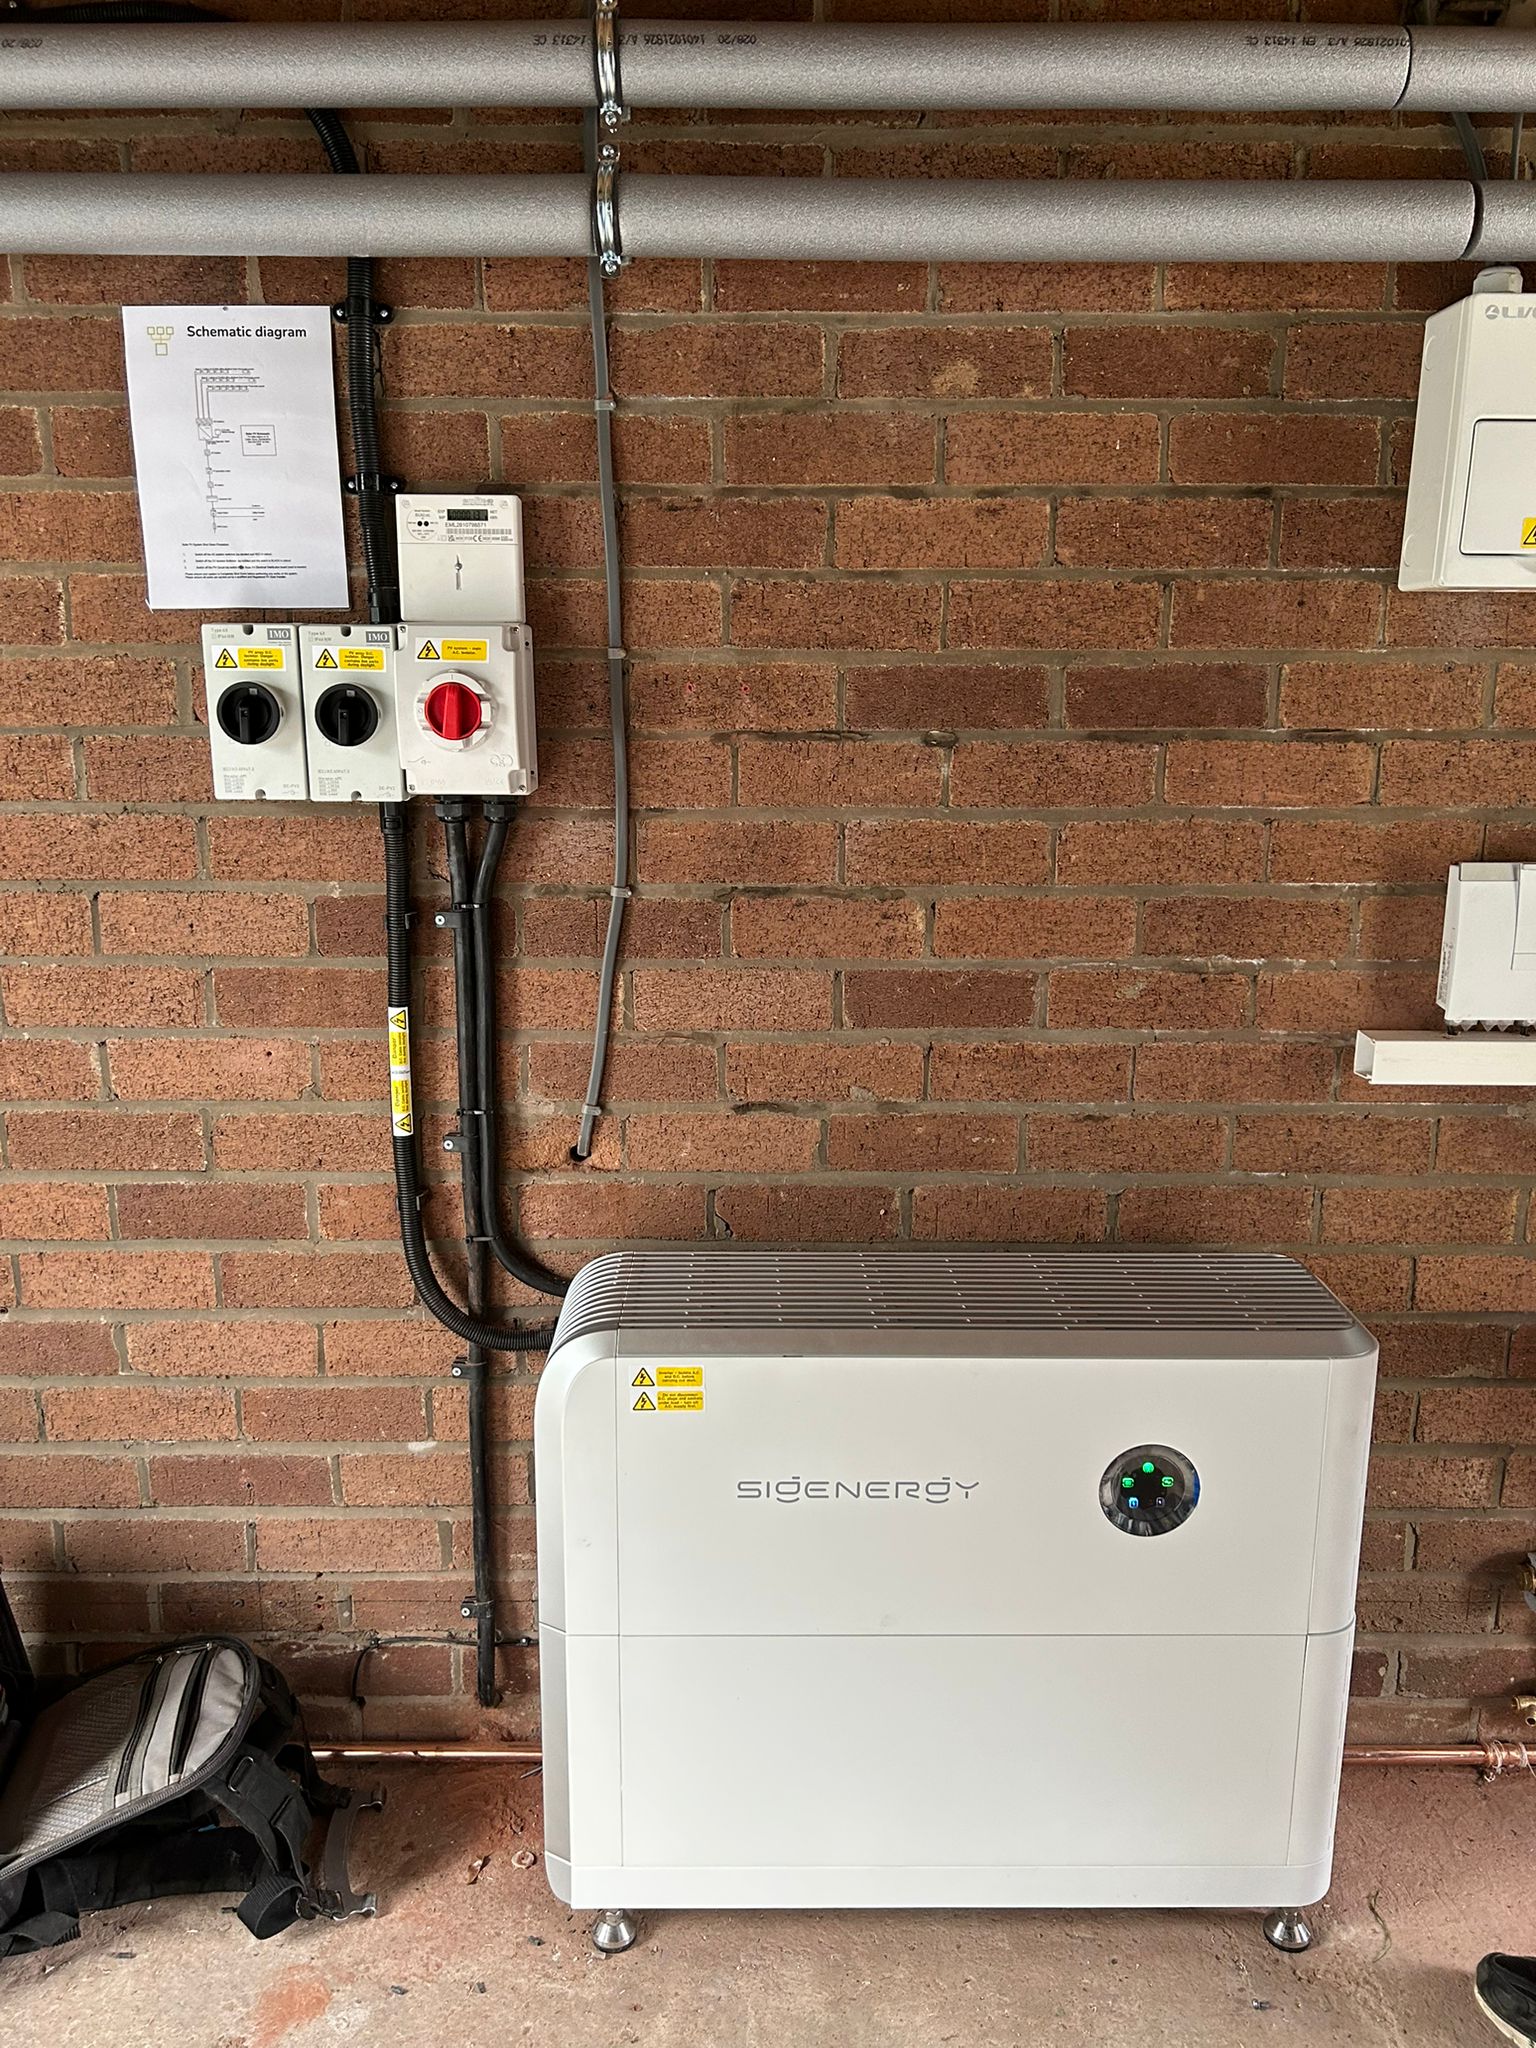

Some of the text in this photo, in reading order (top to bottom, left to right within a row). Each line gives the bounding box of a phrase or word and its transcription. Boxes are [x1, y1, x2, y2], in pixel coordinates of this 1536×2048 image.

[718, 34, 758, 45] 028/20
[1502, 306, 1536, 319] LIV
[187, 325, 307, 339] Schematic diagram
[269, 630, 289, 639] IMO
[368, 633, 387, 641] IMO
[737, 1476, 979, 1503] SIGENERGY
